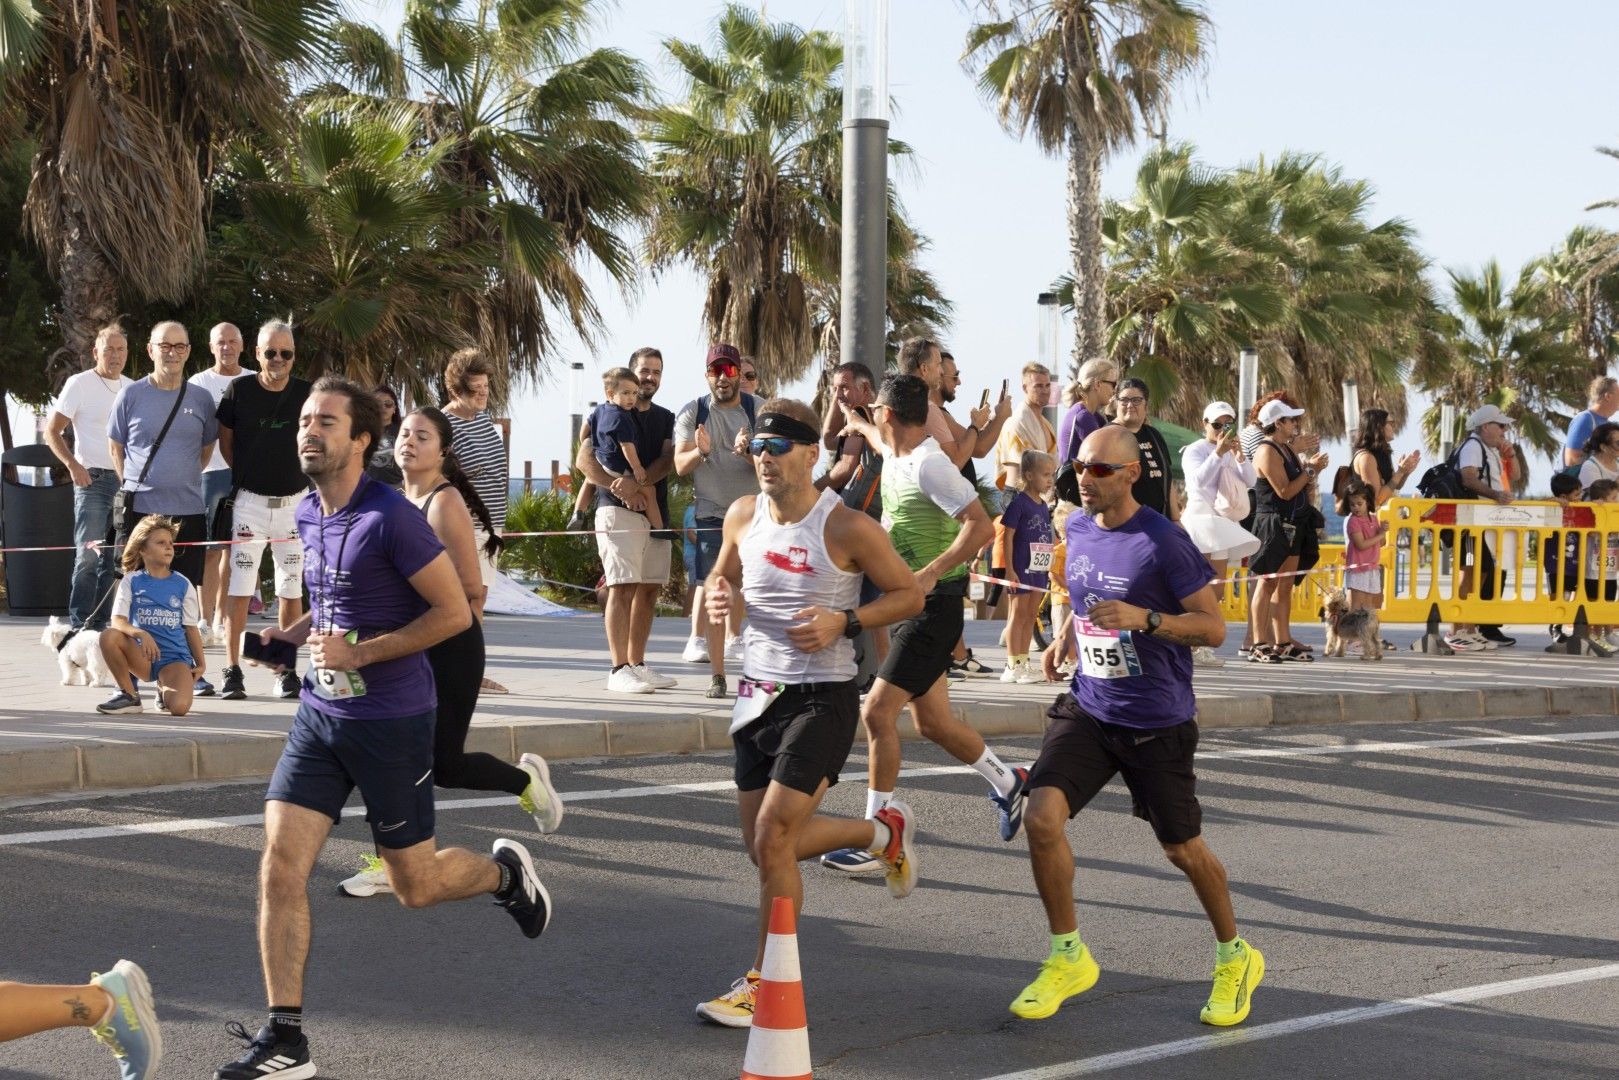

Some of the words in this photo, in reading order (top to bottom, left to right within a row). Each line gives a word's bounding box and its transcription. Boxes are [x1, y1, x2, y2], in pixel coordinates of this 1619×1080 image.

[1033, 552, 1051, 567] 528
[137, 607, 152, 616] Club
[1084, 646, 1120, 667] 155
